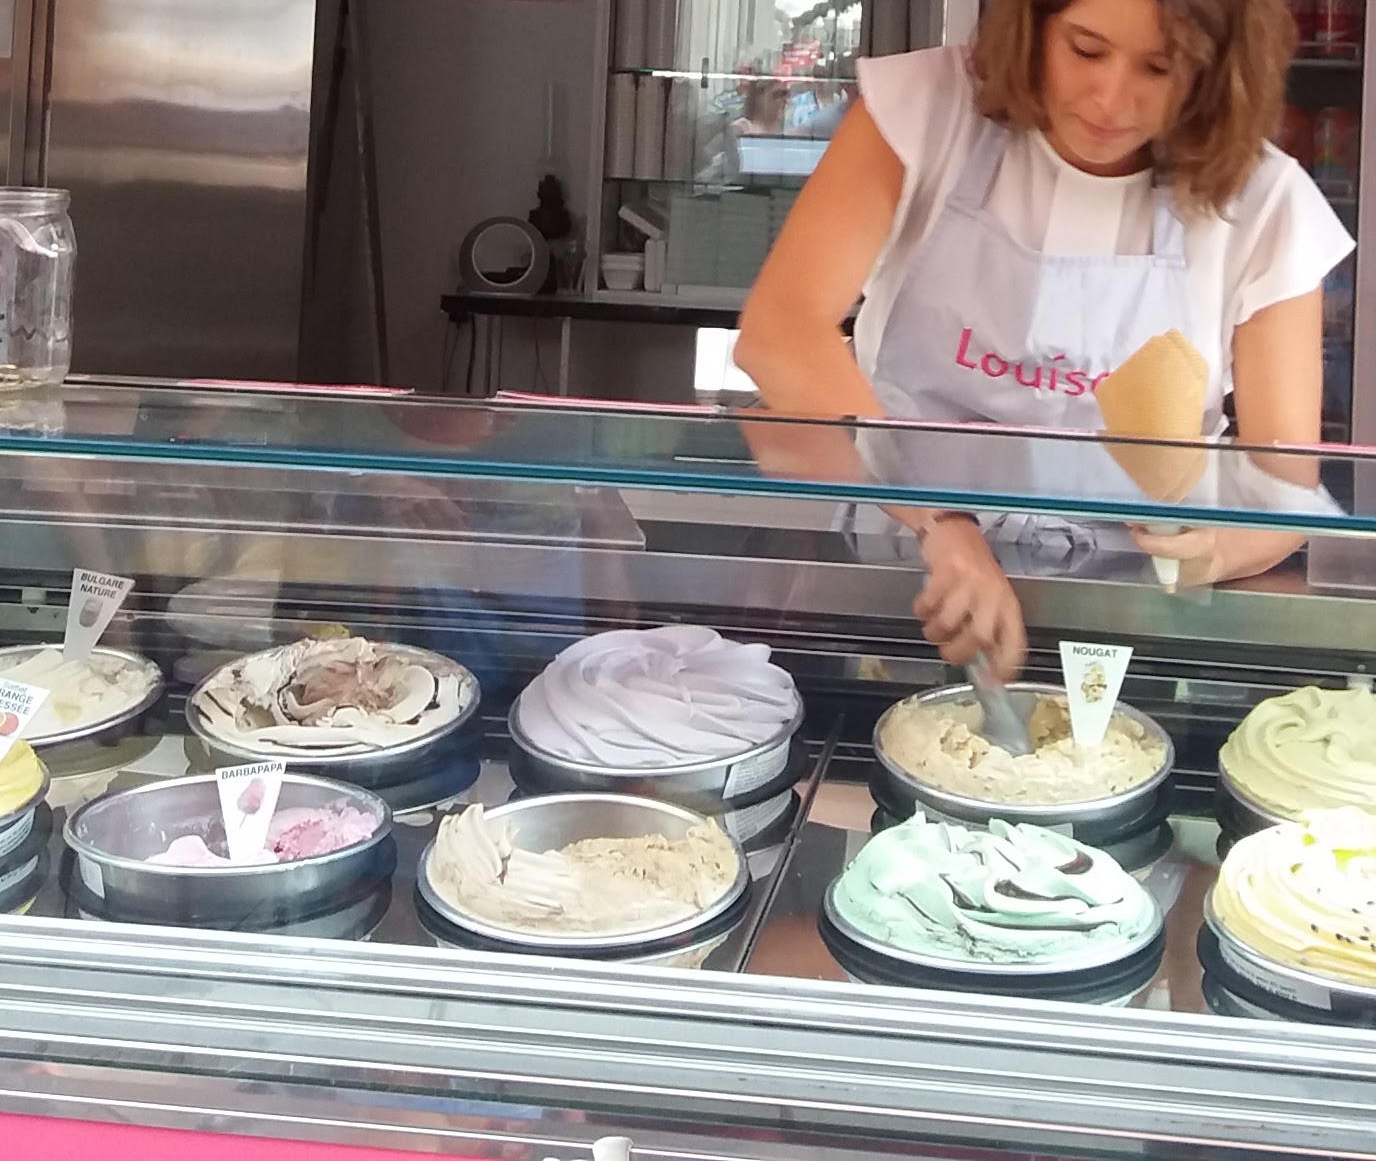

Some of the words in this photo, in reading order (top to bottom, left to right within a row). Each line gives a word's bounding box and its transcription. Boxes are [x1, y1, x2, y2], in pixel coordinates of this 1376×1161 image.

[80, 572, 125, 590] BULGARE
[79, 583, 117, 599] NATURE
[1072, 646, 1118, 658] NOUGAT
[221, 762, 284, 780] BARBAPAPA
